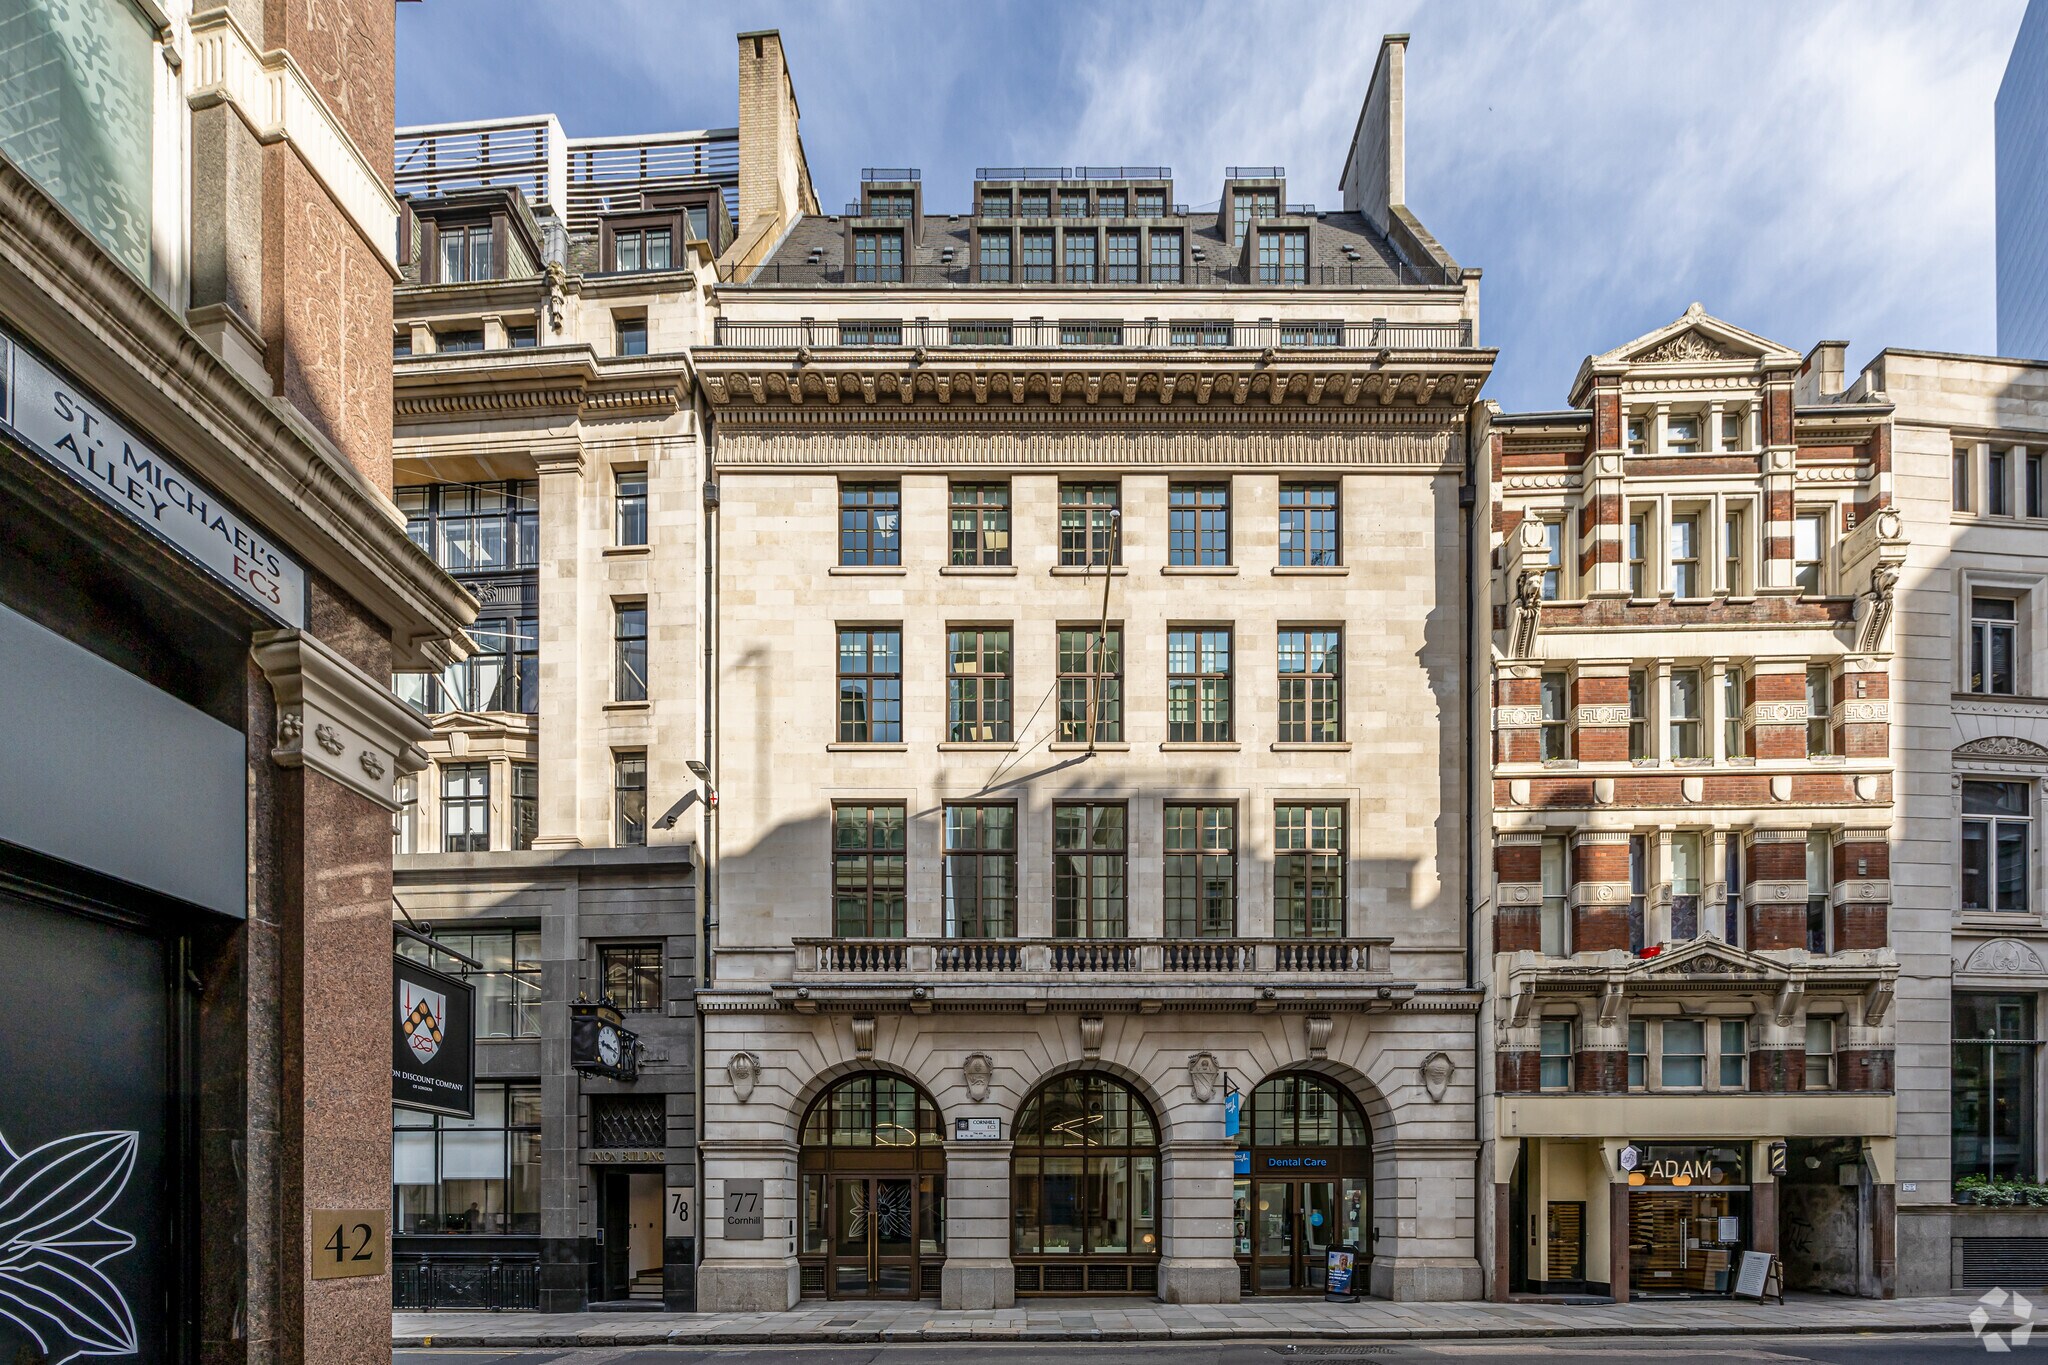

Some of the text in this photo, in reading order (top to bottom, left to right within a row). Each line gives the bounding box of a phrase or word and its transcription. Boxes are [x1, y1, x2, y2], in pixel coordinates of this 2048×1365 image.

[53, 391, 281, 578] ST. MICHAEL'S
[54, 433, 169, 521] ALLEY
[232, 553, 281, 605] EC3
[402, 1071, 434, 1085] DISCOUNT
[435, 1078, 464, 1092] COMPANY
[621, 1151, 665, 1162] BUILDING
[1268, 1158, 1327, 1167] Dental Care
[1650, 1160, 1711, 1178] ADAM
[730, 1193, 758, 1212] 77
[727, 1216, 761, 1225] Cornhill
[324, 1223, 373, 1262] 42
